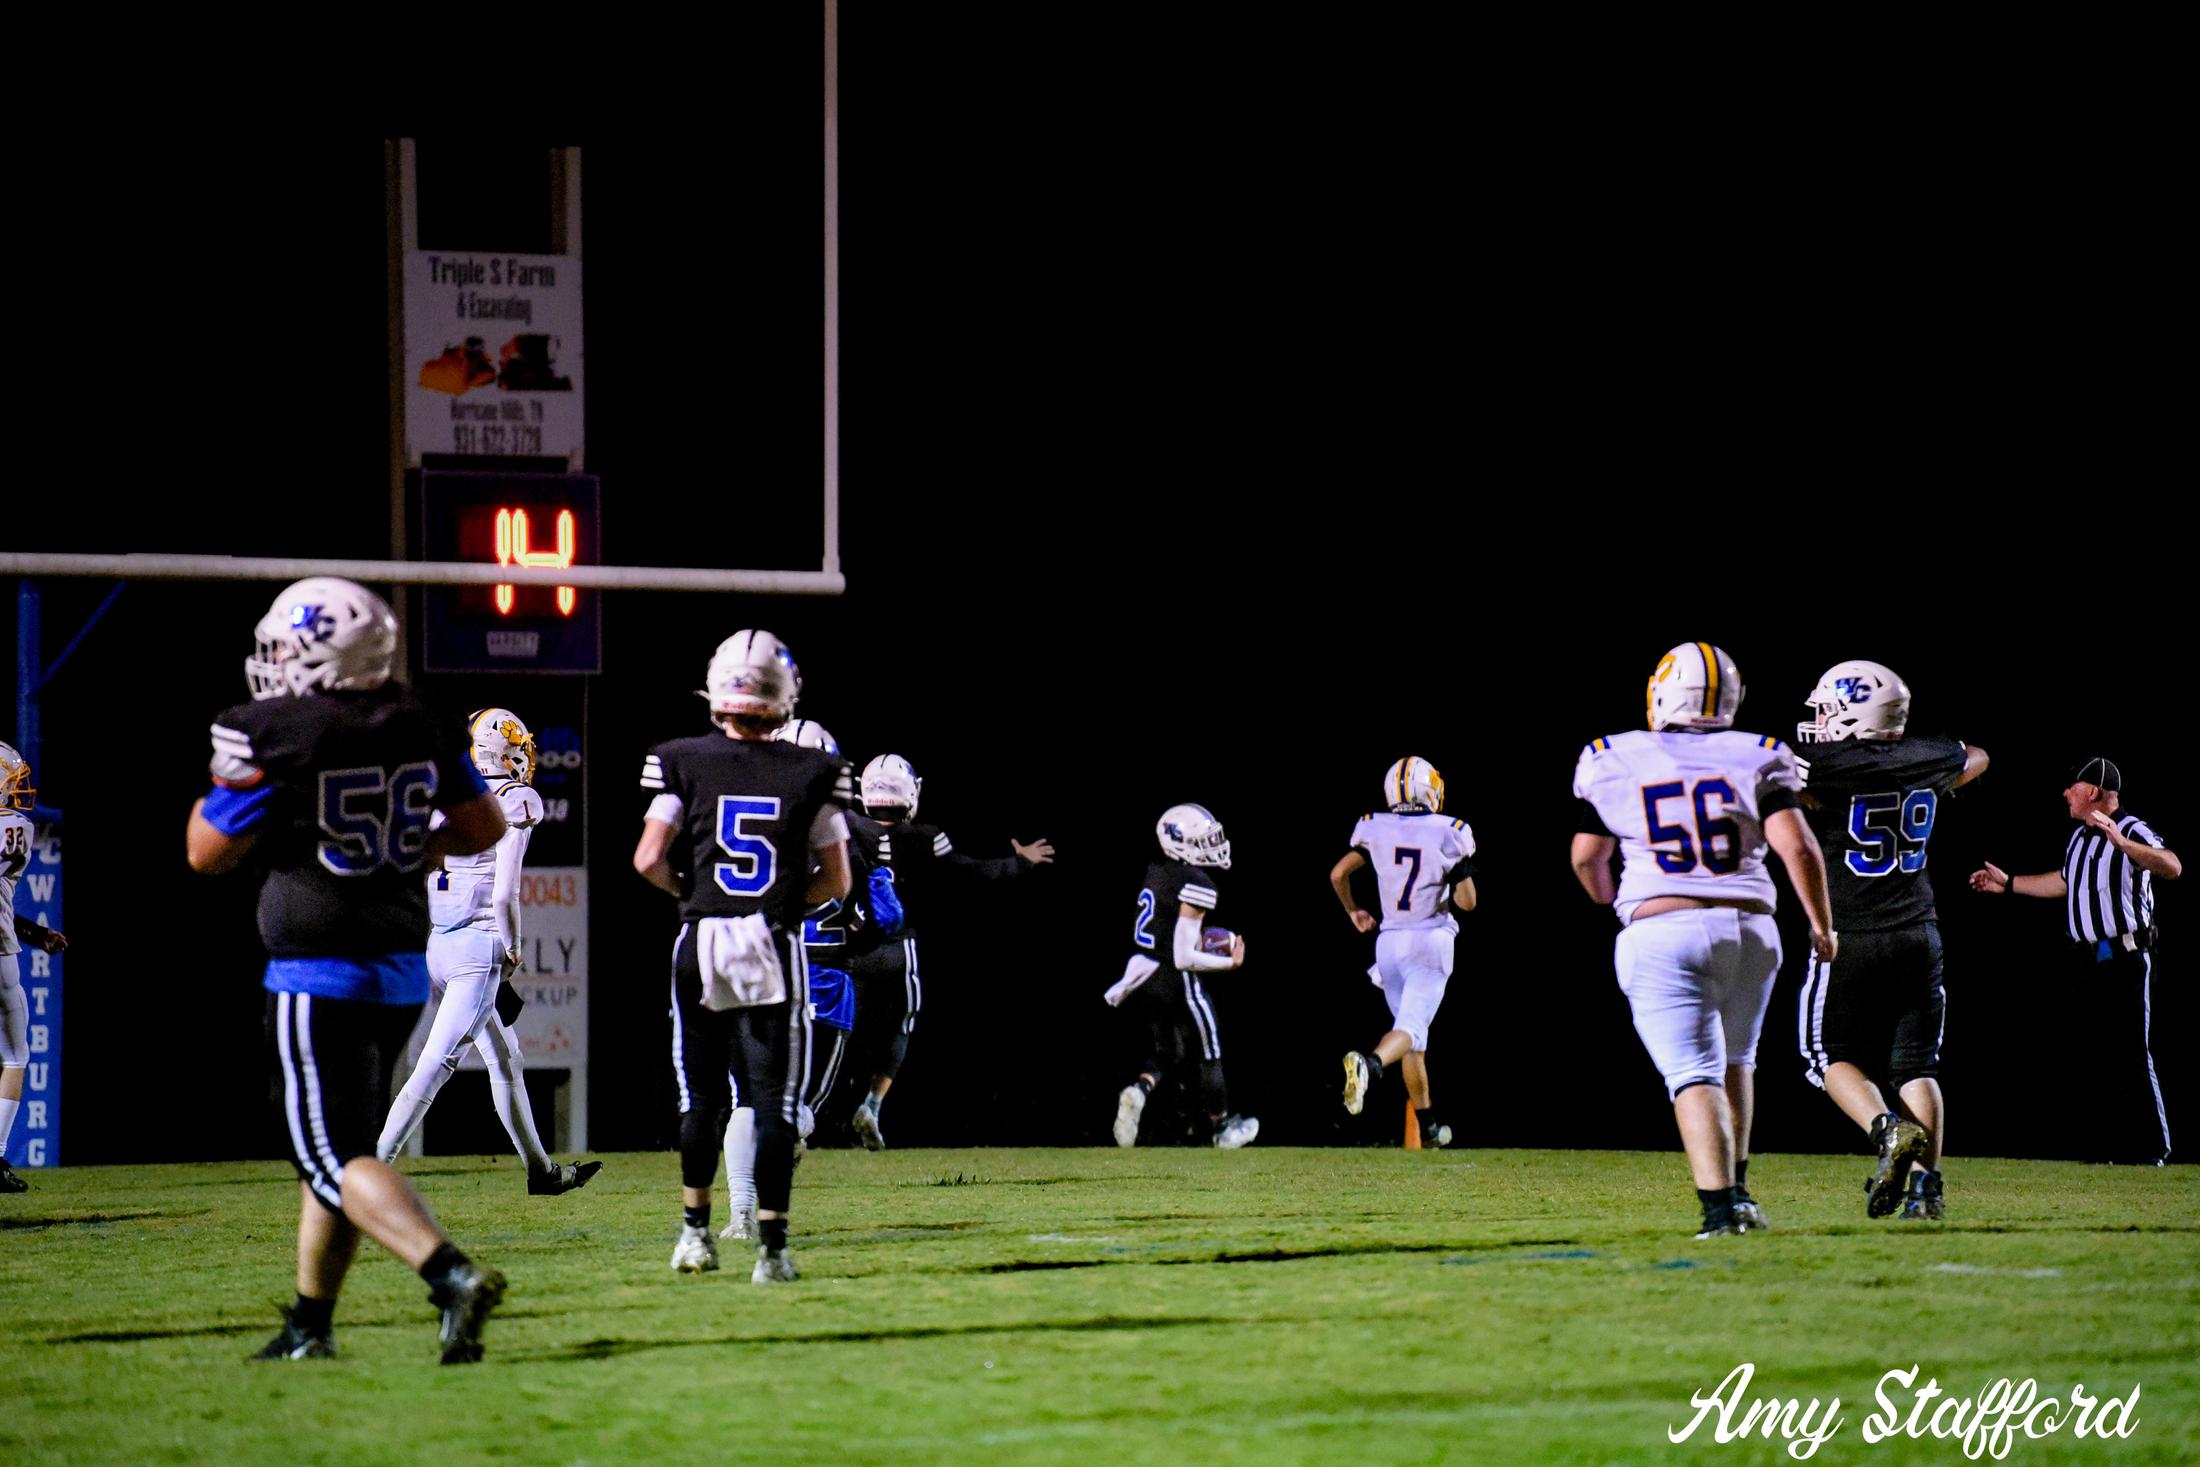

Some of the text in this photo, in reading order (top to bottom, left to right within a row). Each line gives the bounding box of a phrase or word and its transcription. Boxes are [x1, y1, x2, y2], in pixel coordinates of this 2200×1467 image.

[428, 256, 555, 288] Triple S Farm
[496, 507, 575, 617] 14
[5, 826, 24, 847] 32
[317, 759, 439, 877] 56
[713, 794, 781, 897] 5
[1640, 776, 1740, 877] 56
[1844, 788, 1937, 877] 59
[1134, 888, 1155, 950] 2
[1394, 846, 1423, 912] 7
